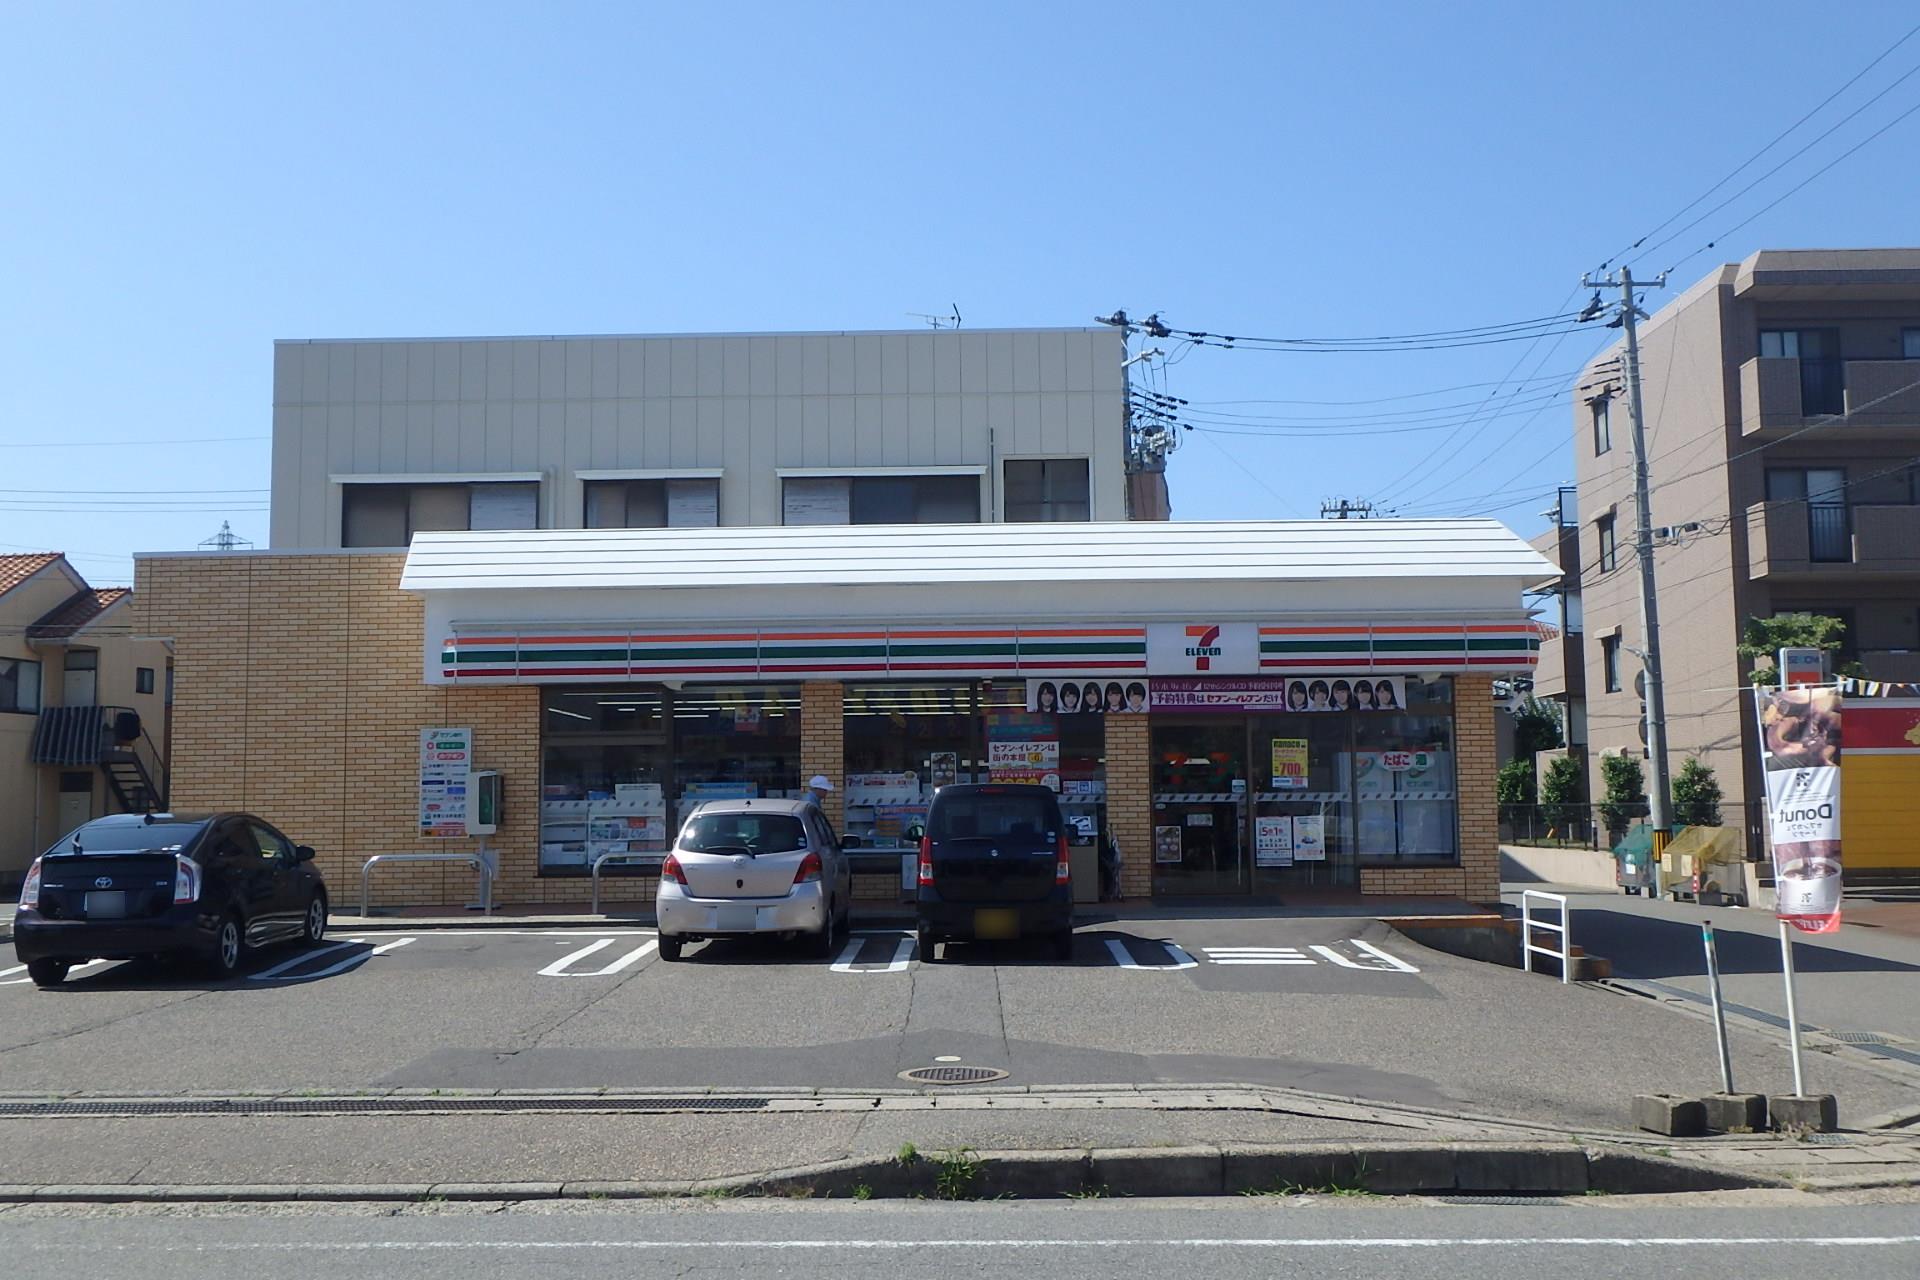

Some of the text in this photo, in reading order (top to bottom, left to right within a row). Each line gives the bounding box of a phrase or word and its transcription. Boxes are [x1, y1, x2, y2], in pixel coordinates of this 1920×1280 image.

[1383, 754, 1411, 766] たばこ
[1280, 762, 1301, 776] 700
